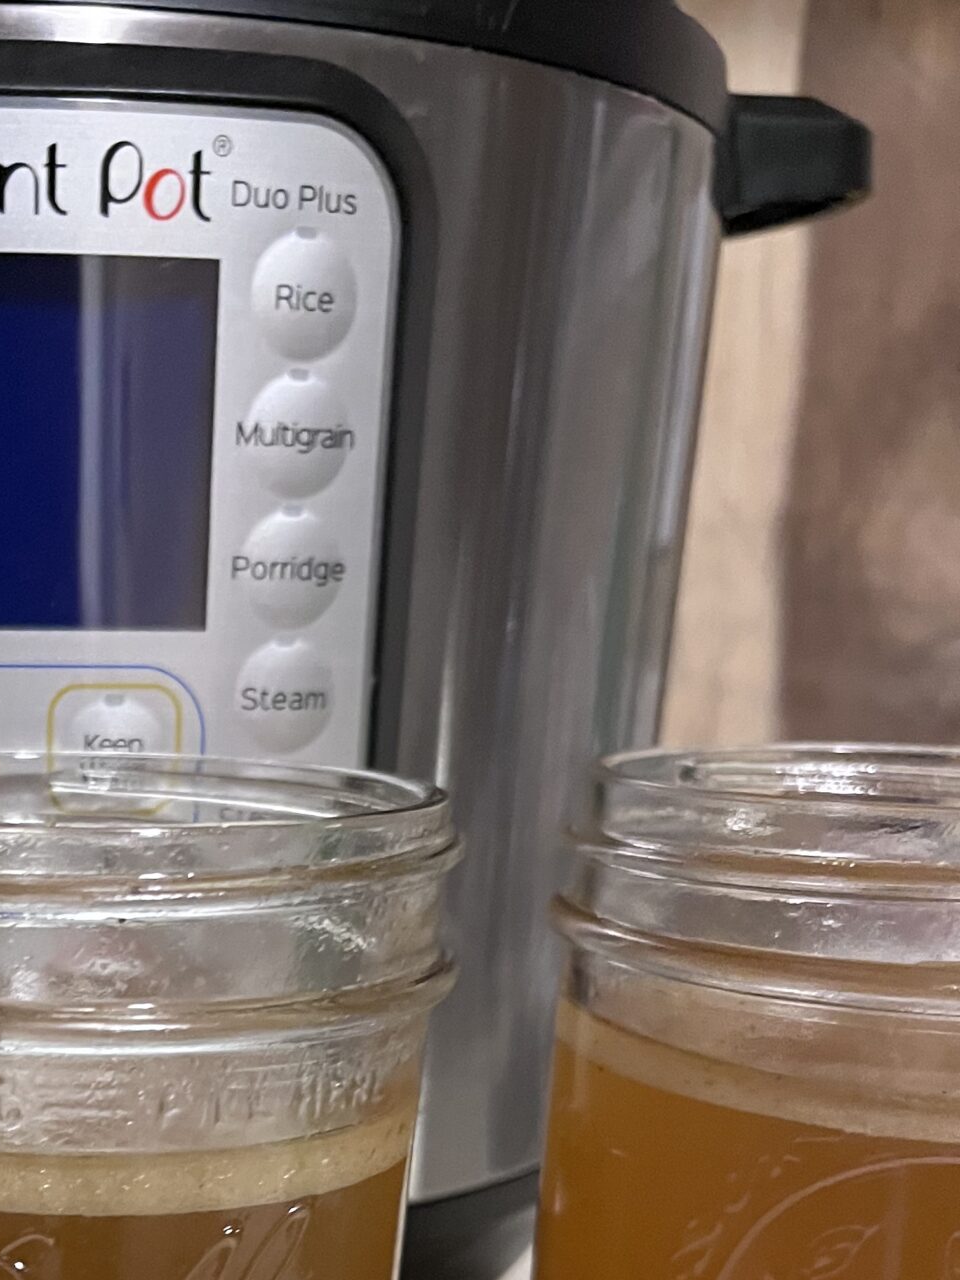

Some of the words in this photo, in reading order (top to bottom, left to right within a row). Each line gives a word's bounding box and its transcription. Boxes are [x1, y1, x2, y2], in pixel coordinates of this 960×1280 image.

[100, 140, 212, 222] Pot
[232, 180, 289, 210] Duo
[298, 185, 358, 216] Plus
[275, 286, 335, 313] Rice
[236, 422, 354, 452] Multigrain
[231, 556, 346, 586] Porridge
[241, 687, 327, 711] Steam
